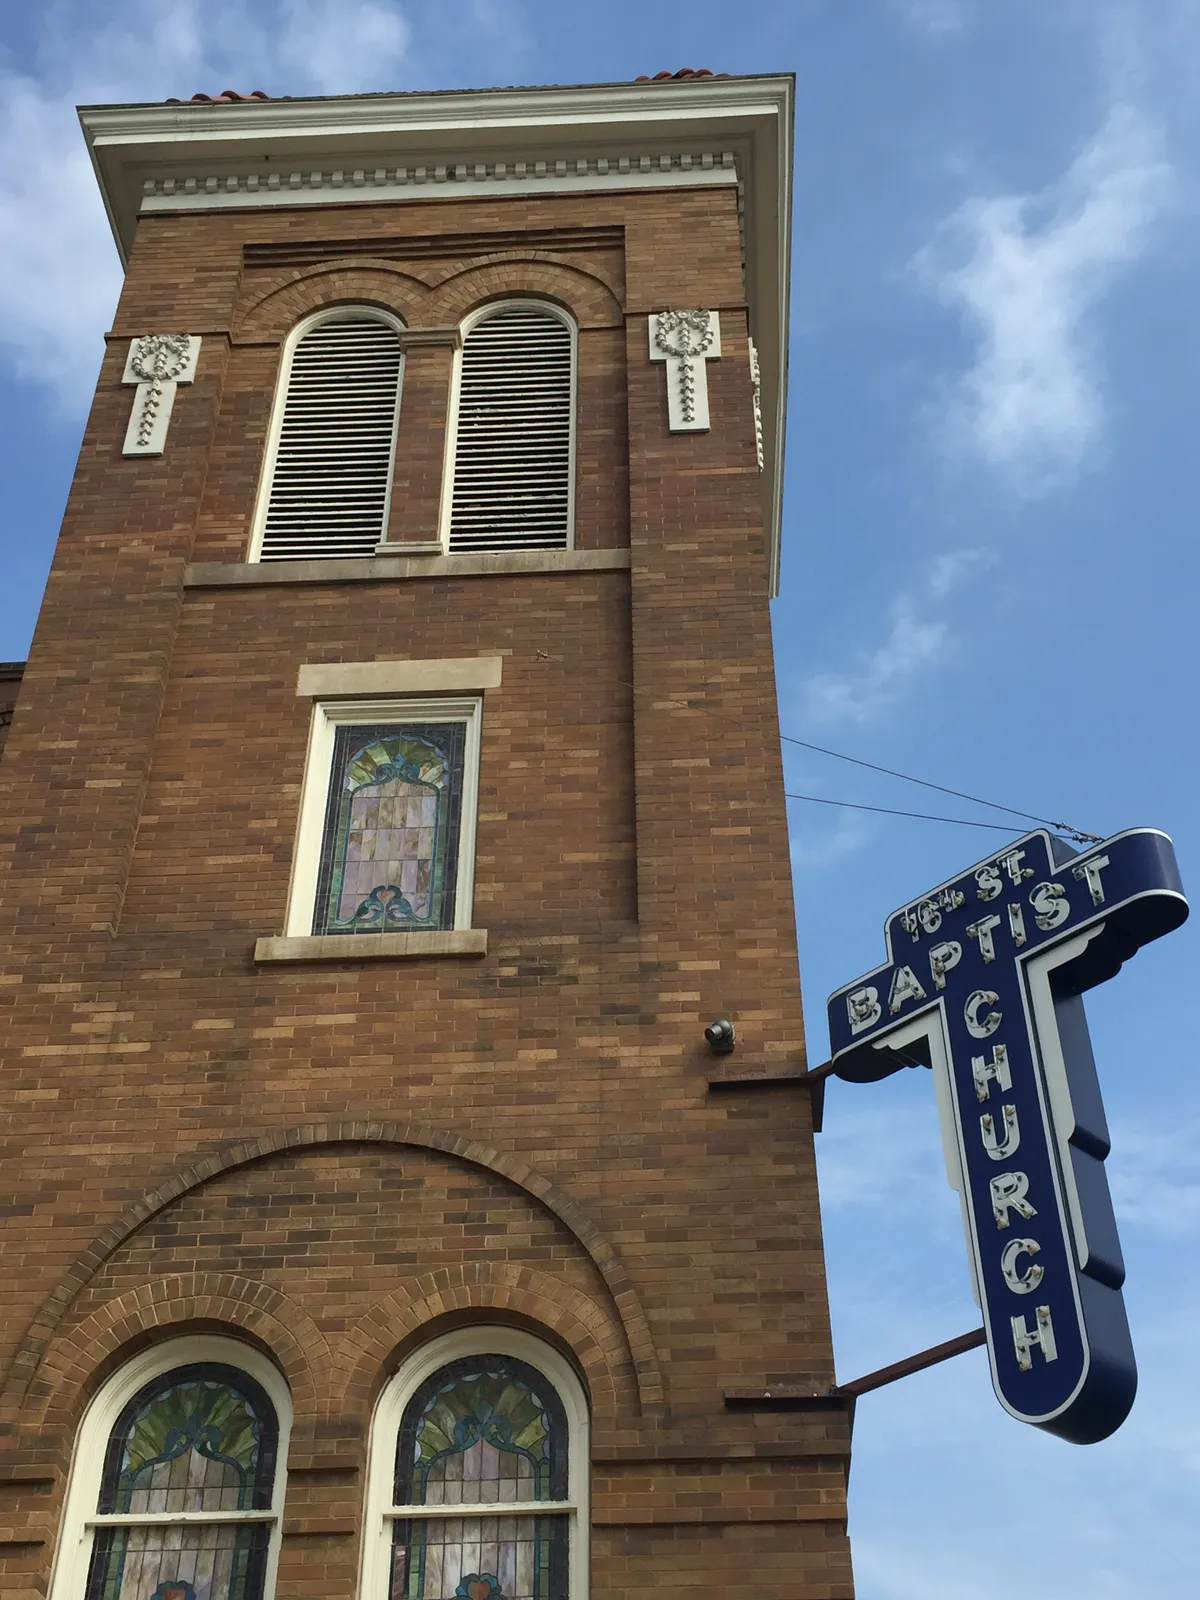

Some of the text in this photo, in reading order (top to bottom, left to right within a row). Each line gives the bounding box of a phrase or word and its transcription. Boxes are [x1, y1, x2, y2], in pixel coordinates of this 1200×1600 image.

[846, 855, 1110, 1035] BAPTIST
[975, 850, 1030, 901] ST
[963, 989, 1060, 1371] CHURCH
